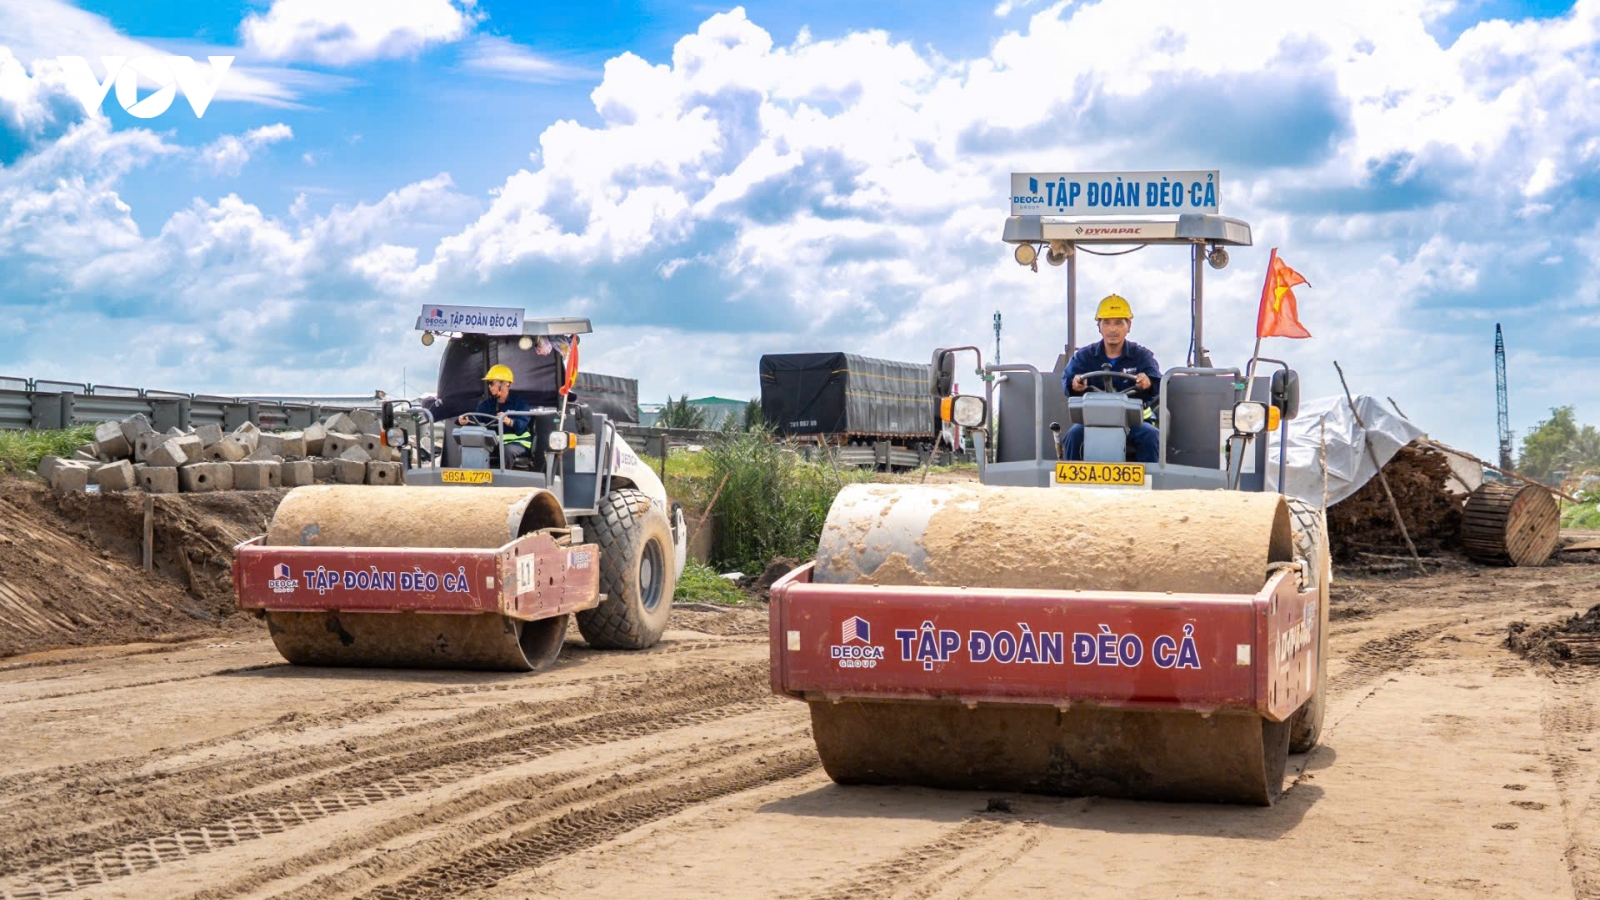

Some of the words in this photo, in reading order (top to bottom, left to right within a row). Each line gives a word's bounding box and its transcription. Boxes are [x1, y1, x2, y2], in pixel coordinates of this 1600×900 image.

[1013, 195, 1044, 204] DEOCA
[1045, 177, 1081, 212] TẬP
[1087, 176, 1140, 207] ĐOÀN
[1146, 176, 1184, 207] ĐÈO
[1190, 173, 1216, 207] CẢ
[450, 311, 464, 328] TẬP
[466, 312, 488, 327] ĐOÀN
[489, 313, 505, 328] ĐÈO
[506, 313, 518, 328] CẢ
[1058, 464, 1142, 483] 43SA-0365
[268, 579, 299, 588] DEOCA
[303, 565, 341, 595] TẬP
[343, 565, 396, 591] ĐOÀN
[399, 566, 439, 591] ĐÈO
[442, 565, 470, 593] CẢ
[831, 645, 884, 660] DEOCA
[895, 620, 961, 671] TẬP
[968, 622, 1064, 664] ĐOÀN
[1071, 623, 1144, 668] ĐÈO
[1152, 623, 1202, 669] CẢ
[839, 659, 877, 668] GROUP
